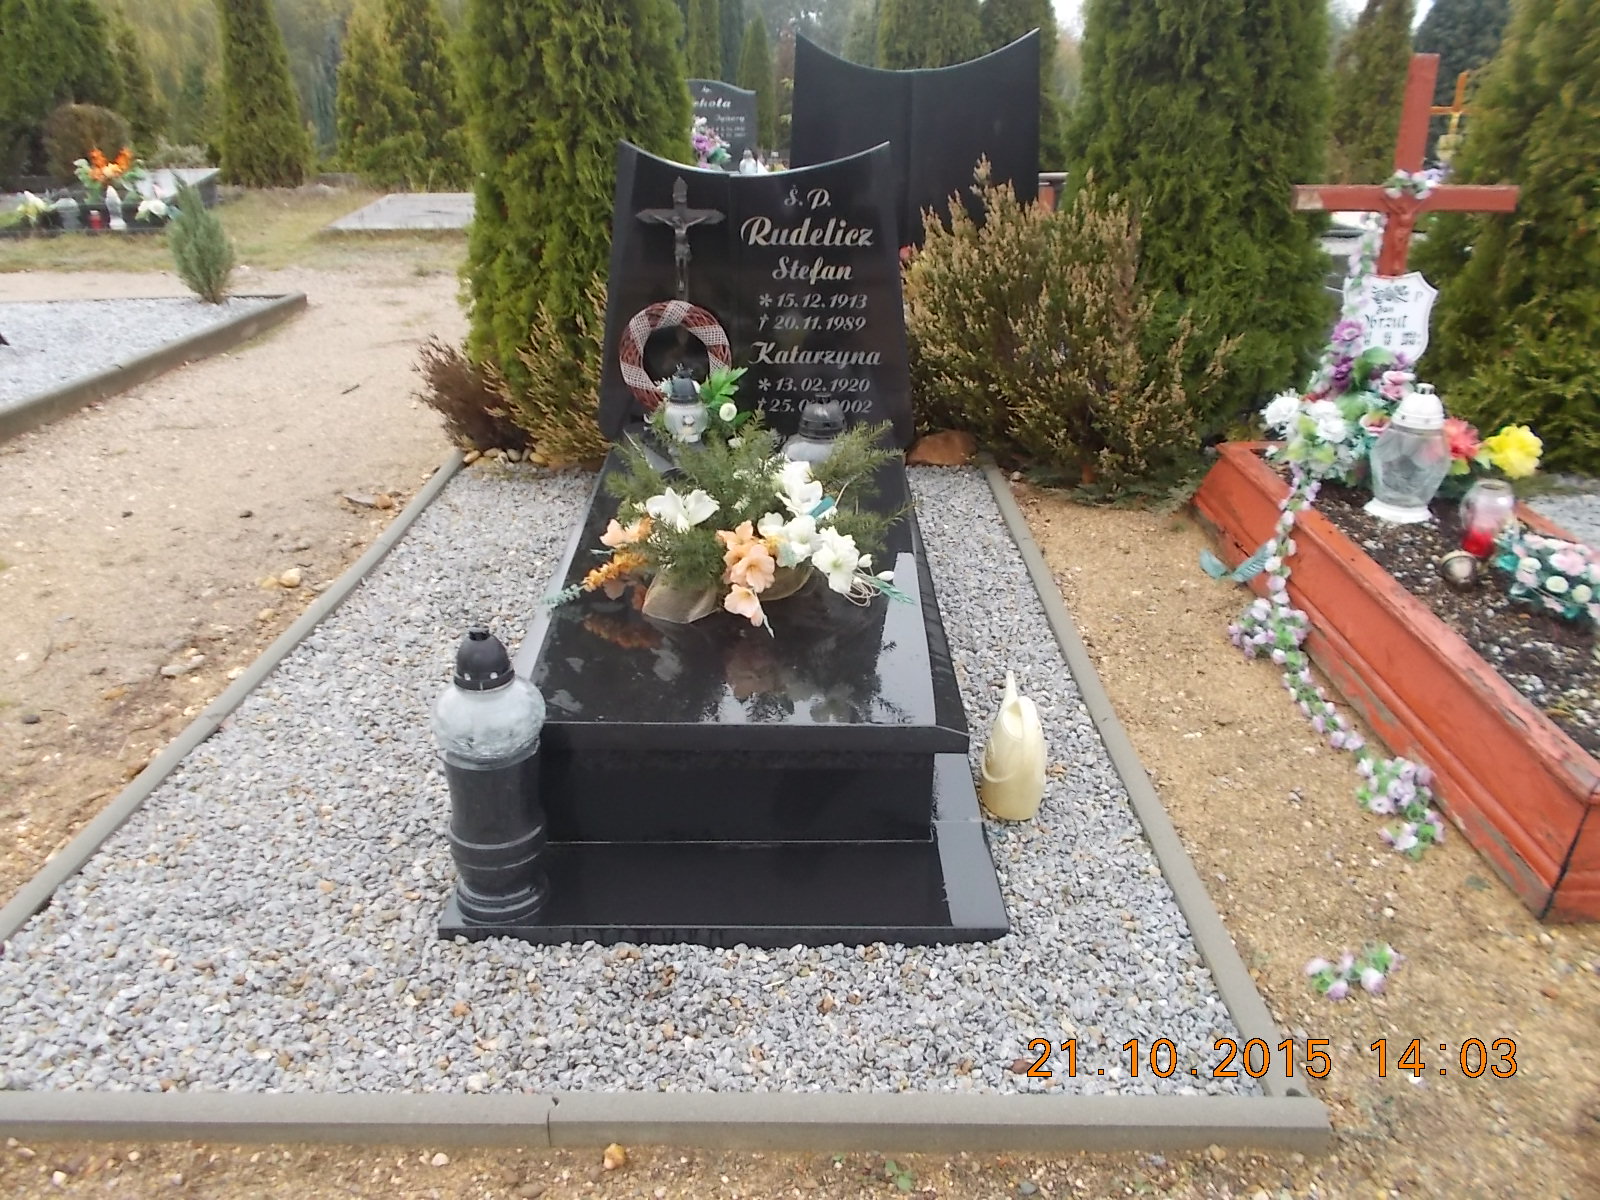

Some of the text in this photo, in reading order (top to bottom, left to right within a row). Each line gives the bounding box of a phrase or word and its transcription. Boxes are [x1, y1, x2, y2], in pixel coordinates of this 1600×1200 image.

[806, 188, 831, 210] P.
[740, 216, 874, 246] Rudelicz
[772, 256, 853, 285] Stefan
[748, 341, 882, 369] Katarzyna
